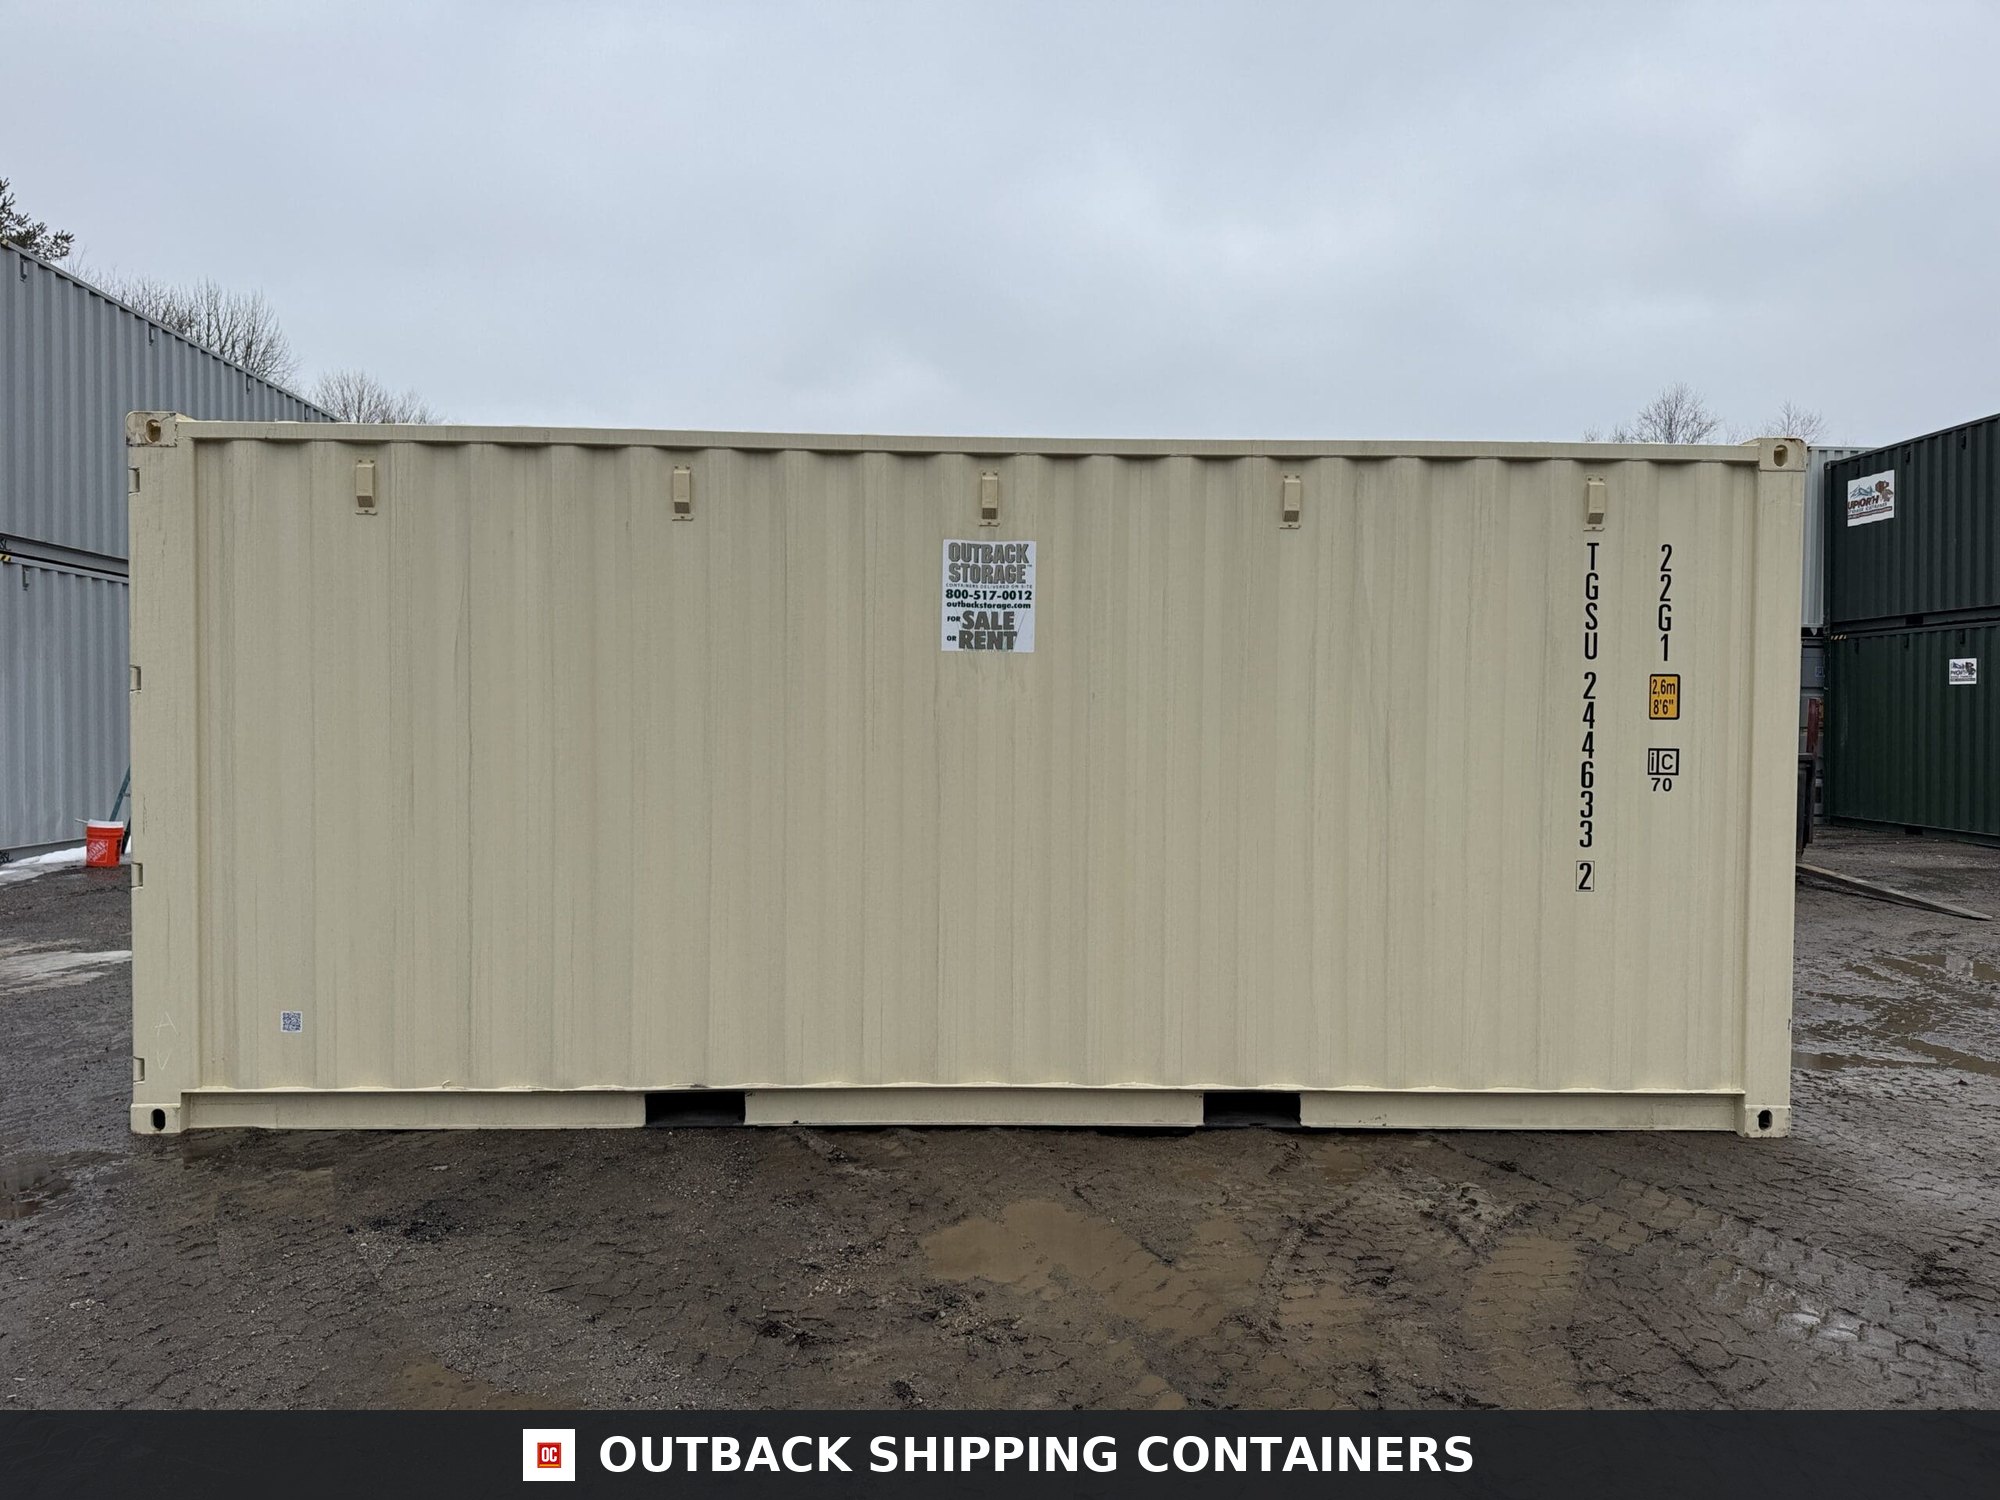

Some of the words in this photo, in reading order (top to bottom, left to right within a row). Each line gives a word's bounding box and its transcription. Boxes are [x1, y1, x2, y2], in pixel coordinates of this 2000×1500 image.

[948, 542, 1029, 564] OUTBACK
[948, 563, 1026, 584] STORAGE
[945, 589, 1032, 601] 800-517-0012
[946, 600, 1031, 610] outbackstorage.com
[1584, 542, 1600, 660] TGSU
[1658, 544, 1673, 661] 22G1
[962, 610, 1015, 630] SALE
[959, 630, 1018, 650] RENT
[1653, 699, 1674, 715] 8'6"
[1579, 671, 1597, 848] 244633
[1651, 777, 1673, 792] 70
[1578, 862, 1592, 890] 2
